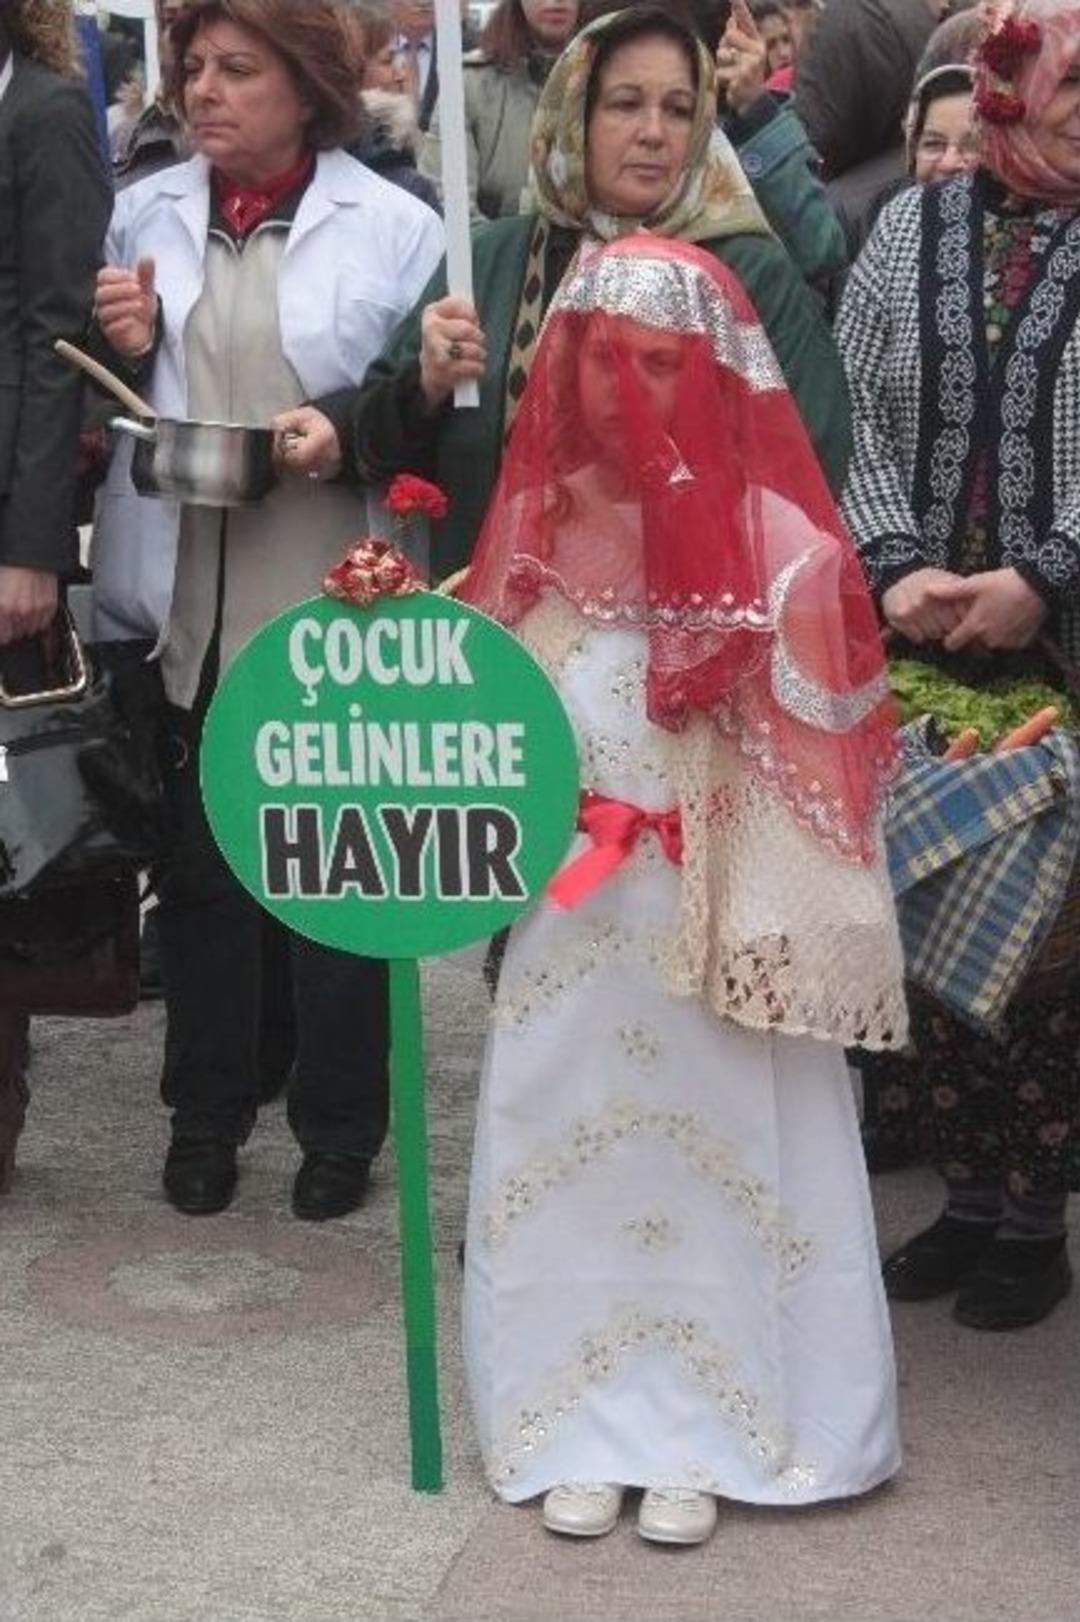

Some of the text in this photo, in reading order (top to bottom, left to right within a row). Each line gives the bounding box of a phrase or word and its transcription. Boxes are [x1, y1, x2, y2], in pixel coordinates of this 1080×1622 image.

[289, 618, 474, 706] ÇOCUK
[255, 703, 526, 787] GELİNLERE
[260, 803, 529, 901] HAYIR
